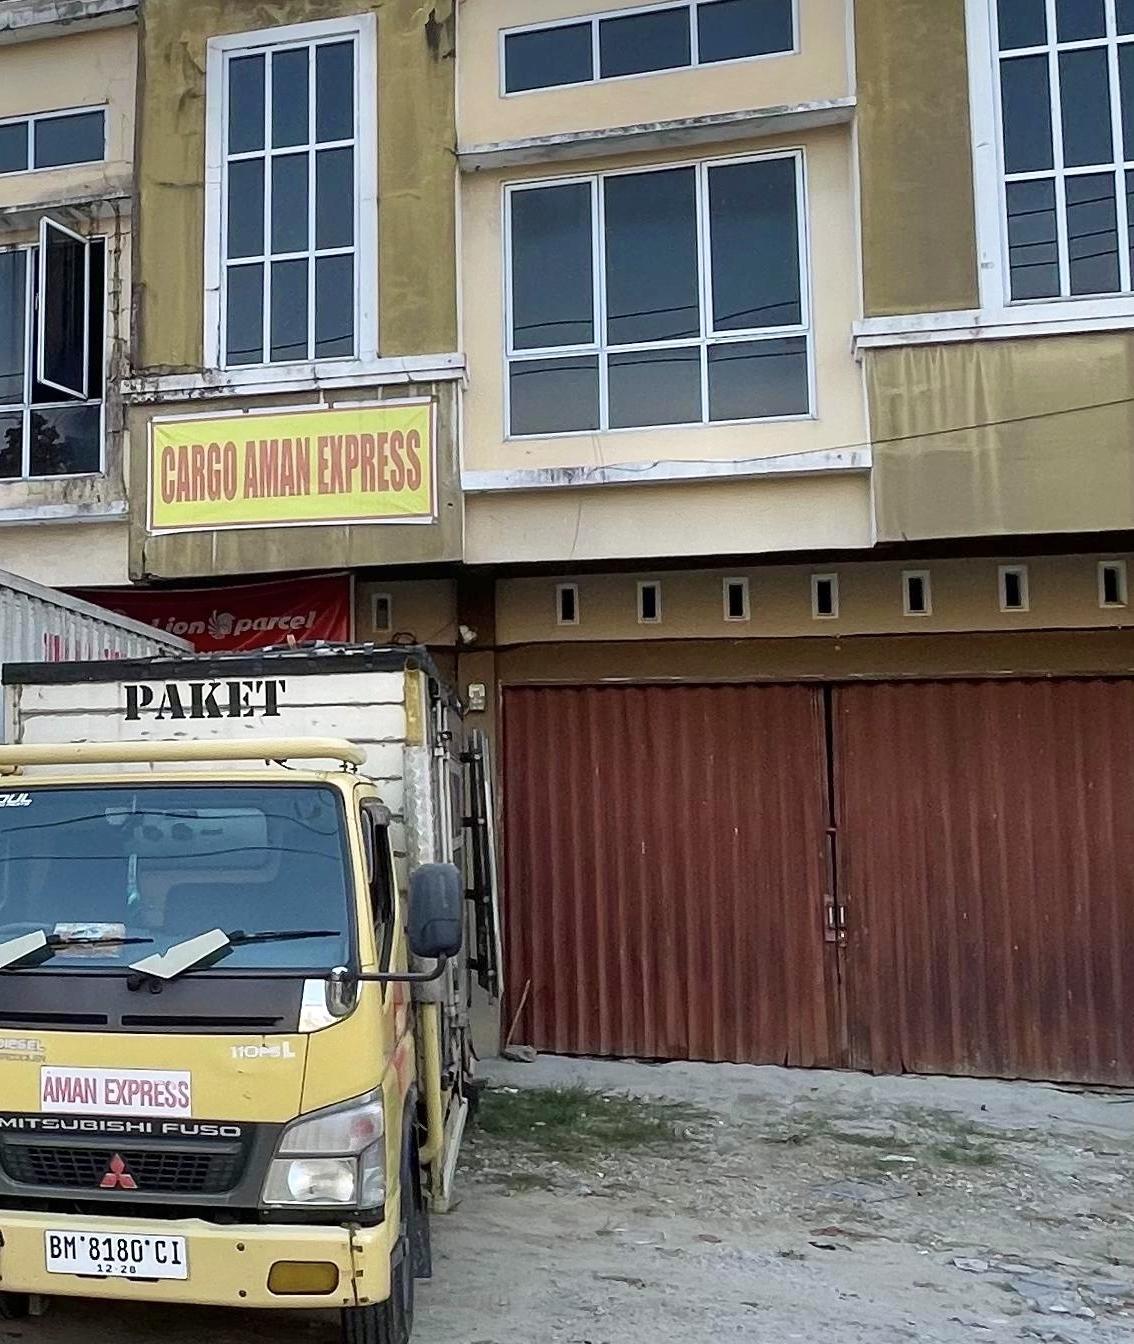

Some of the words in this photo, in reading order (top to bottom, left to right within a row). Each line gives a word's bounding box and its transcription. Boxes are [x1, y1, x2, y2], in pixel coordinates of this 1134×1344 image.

[160, 441, 237, 504] CARGO
[243, 437, 311, 498] AMAN
[317, 429, 421, 495] EXPRESS
[234, 611, 316, 636] parcel
[124, 680, 286, 721] PAKET
[43, 1076, 97, 1105] AMAN
[104, 1078, 190, 1108] EXPRESS
[162, 1123, 242, 1137] FUSO
[50, 1235, 76, 1259] BM
[89, 1237, 143, 1262] 8180
[155, 1241, 181, 1264] CI
